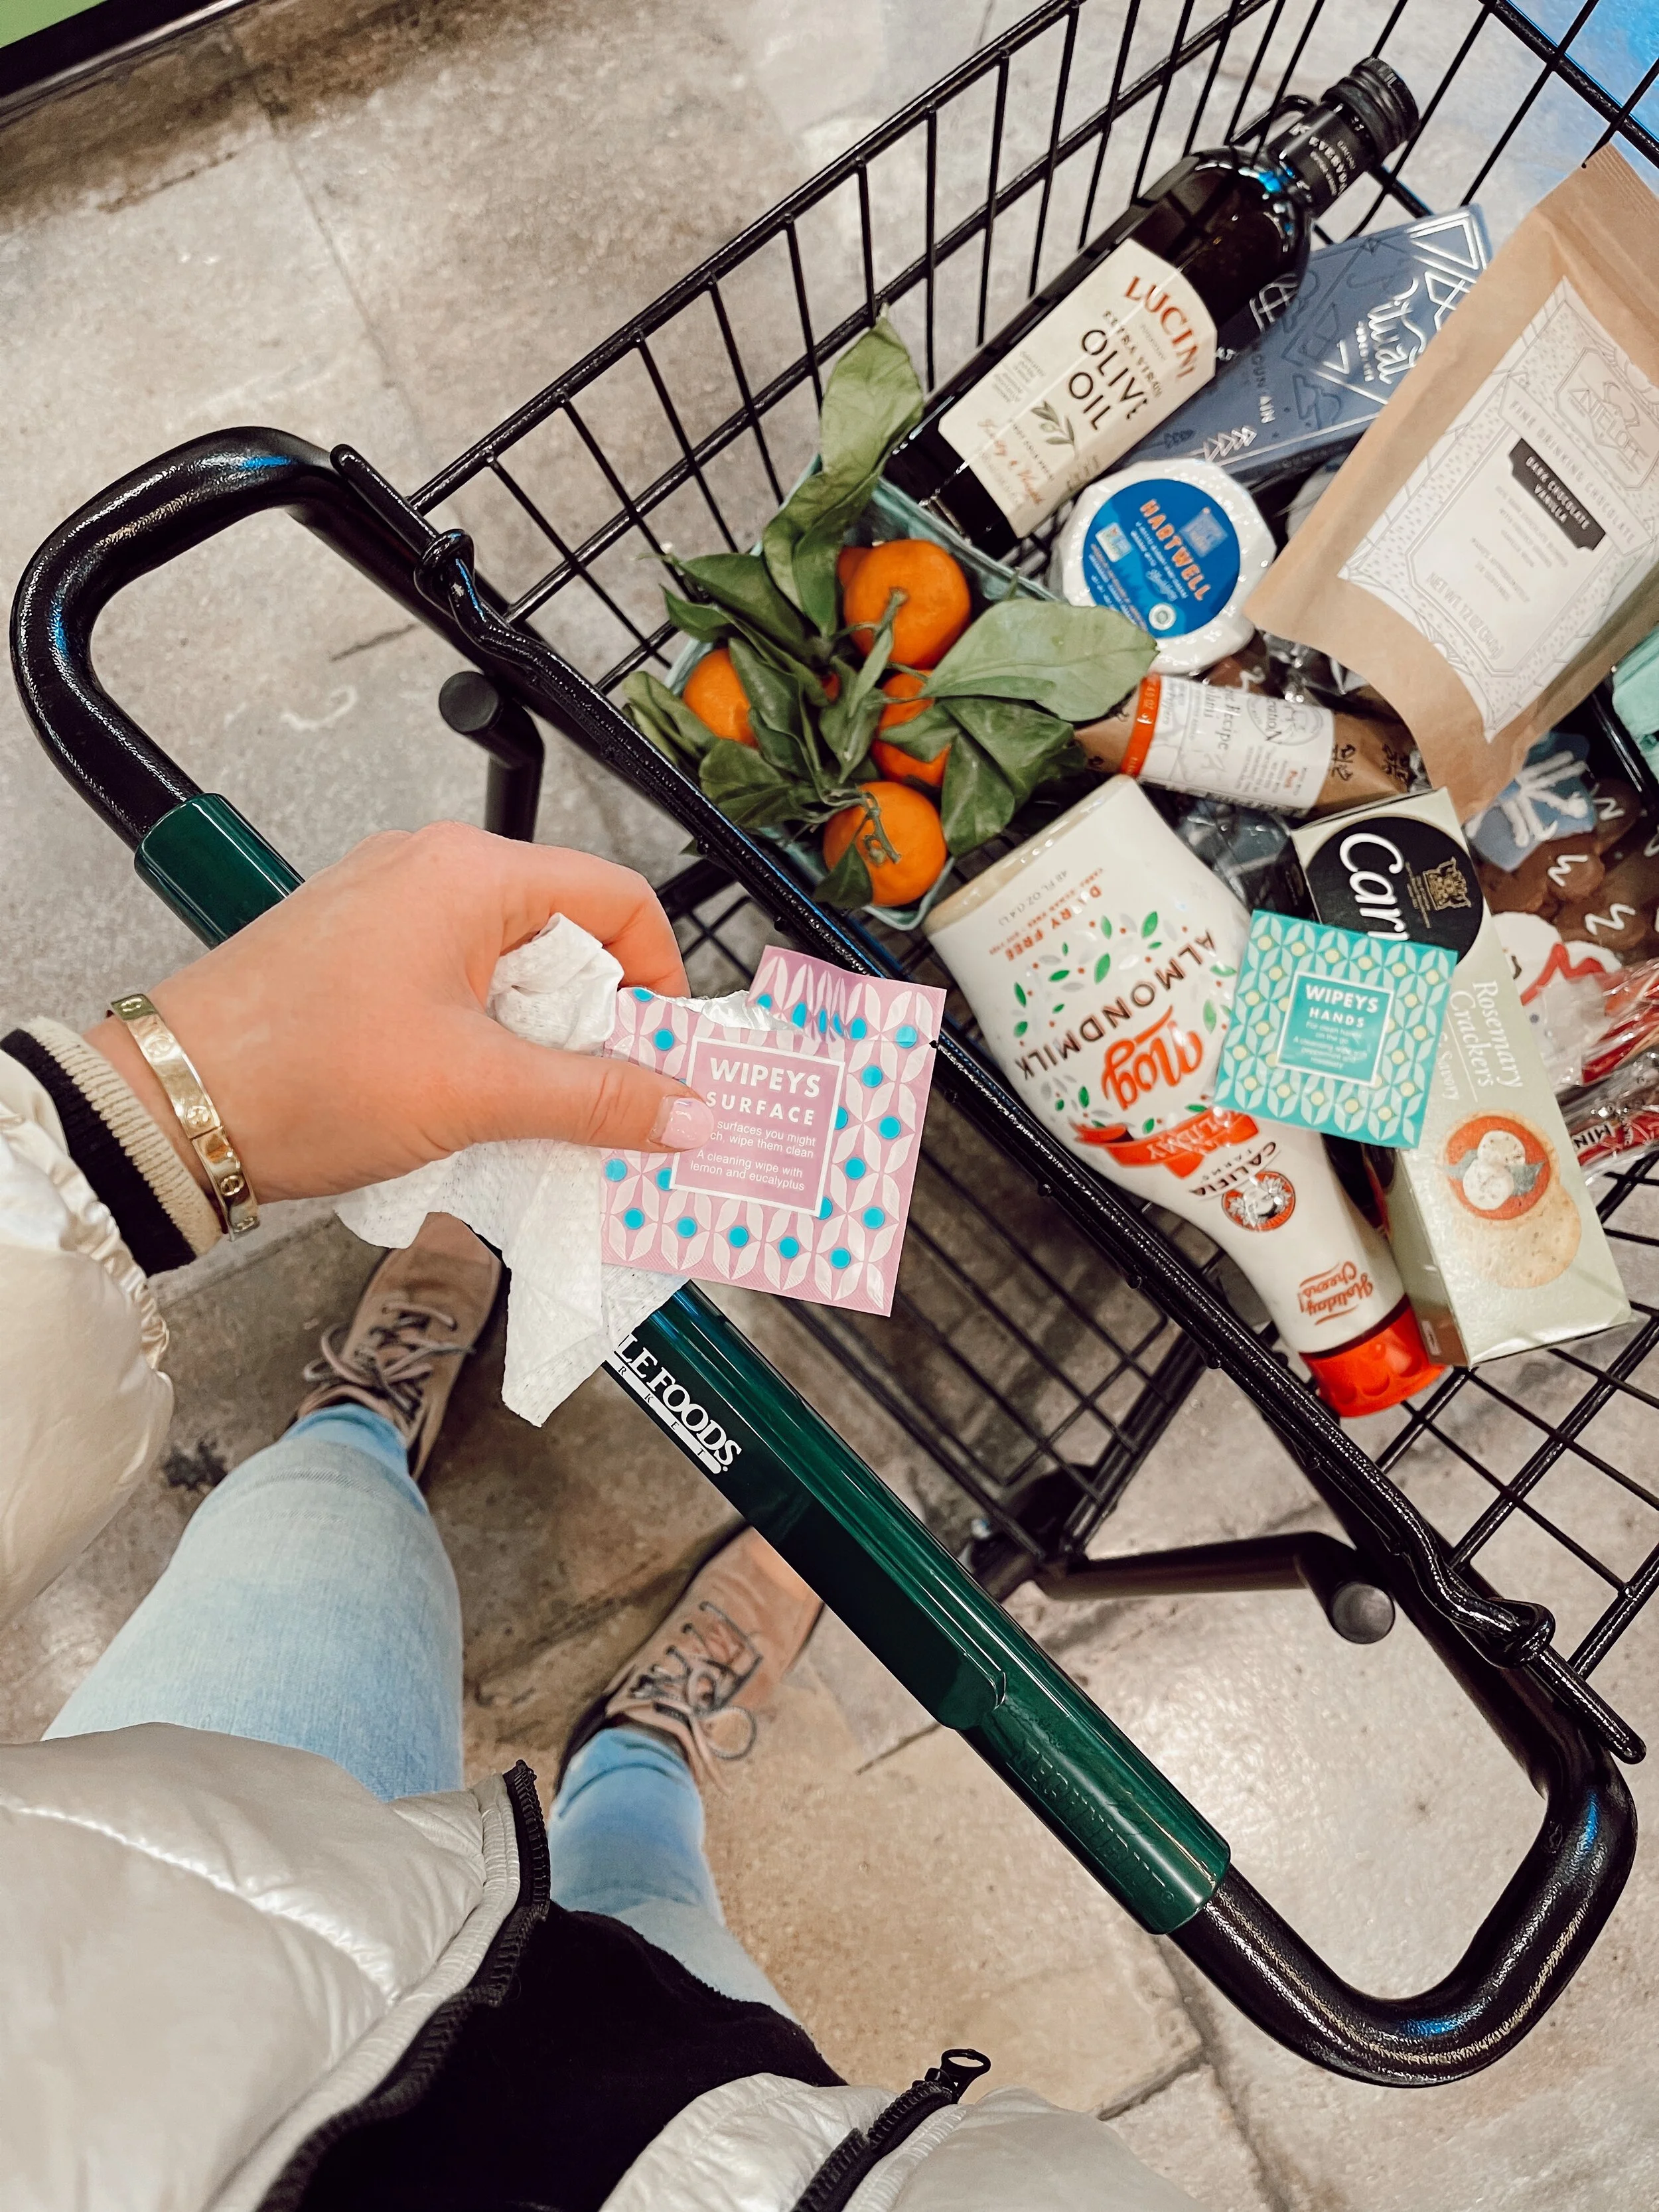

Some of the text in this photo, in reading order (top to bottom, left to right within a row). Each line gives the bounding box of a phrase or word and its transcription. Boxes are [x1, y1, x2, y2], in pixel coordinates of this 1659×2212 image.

[1124, 274, 1196, 380] LUCINI
[1068, 372, 1115, 431] OIL
[1082, 332, 1149, 419] OLIVE
[1138, 497, 1214, 601] HARTWELL
[1003, 883, 1103, 962] DIRY FREE
[1014, 930, 1214, 1081] ALMONDMILK
[1303, 984, 1379, 1013] WIPEYS
[1309, 1006, 1365, 1028] HANDS
[1100, 1005, 1201, 1112] Nog
[1450, 991, 1494, 1086] Crackers
[1472, 982, 1523, 1086] Rosemary
[707, 1056, 822, 1098] WIPEYS
[705, 1090, 814, 1126] SURFACE
[717, 1119, 816, 1148] surfaces you might
[1147, 1110, 1244, 1161] OLIDAY
[697, 1150, 802, 1177] A cleaning wipe with
[728, 1135, 754, 1148] wipe
[756, 1139, 783, 1152] them
[785, 1145, 814, 1158] clean
[1189, 1141, 1275, 1197] CALIFIA
[690, 1161, 805, 1193] lemon and eucalyptus
[617, 1365, 705, 1457] RKET
[646, 1366, 742, 1464] FOODS
